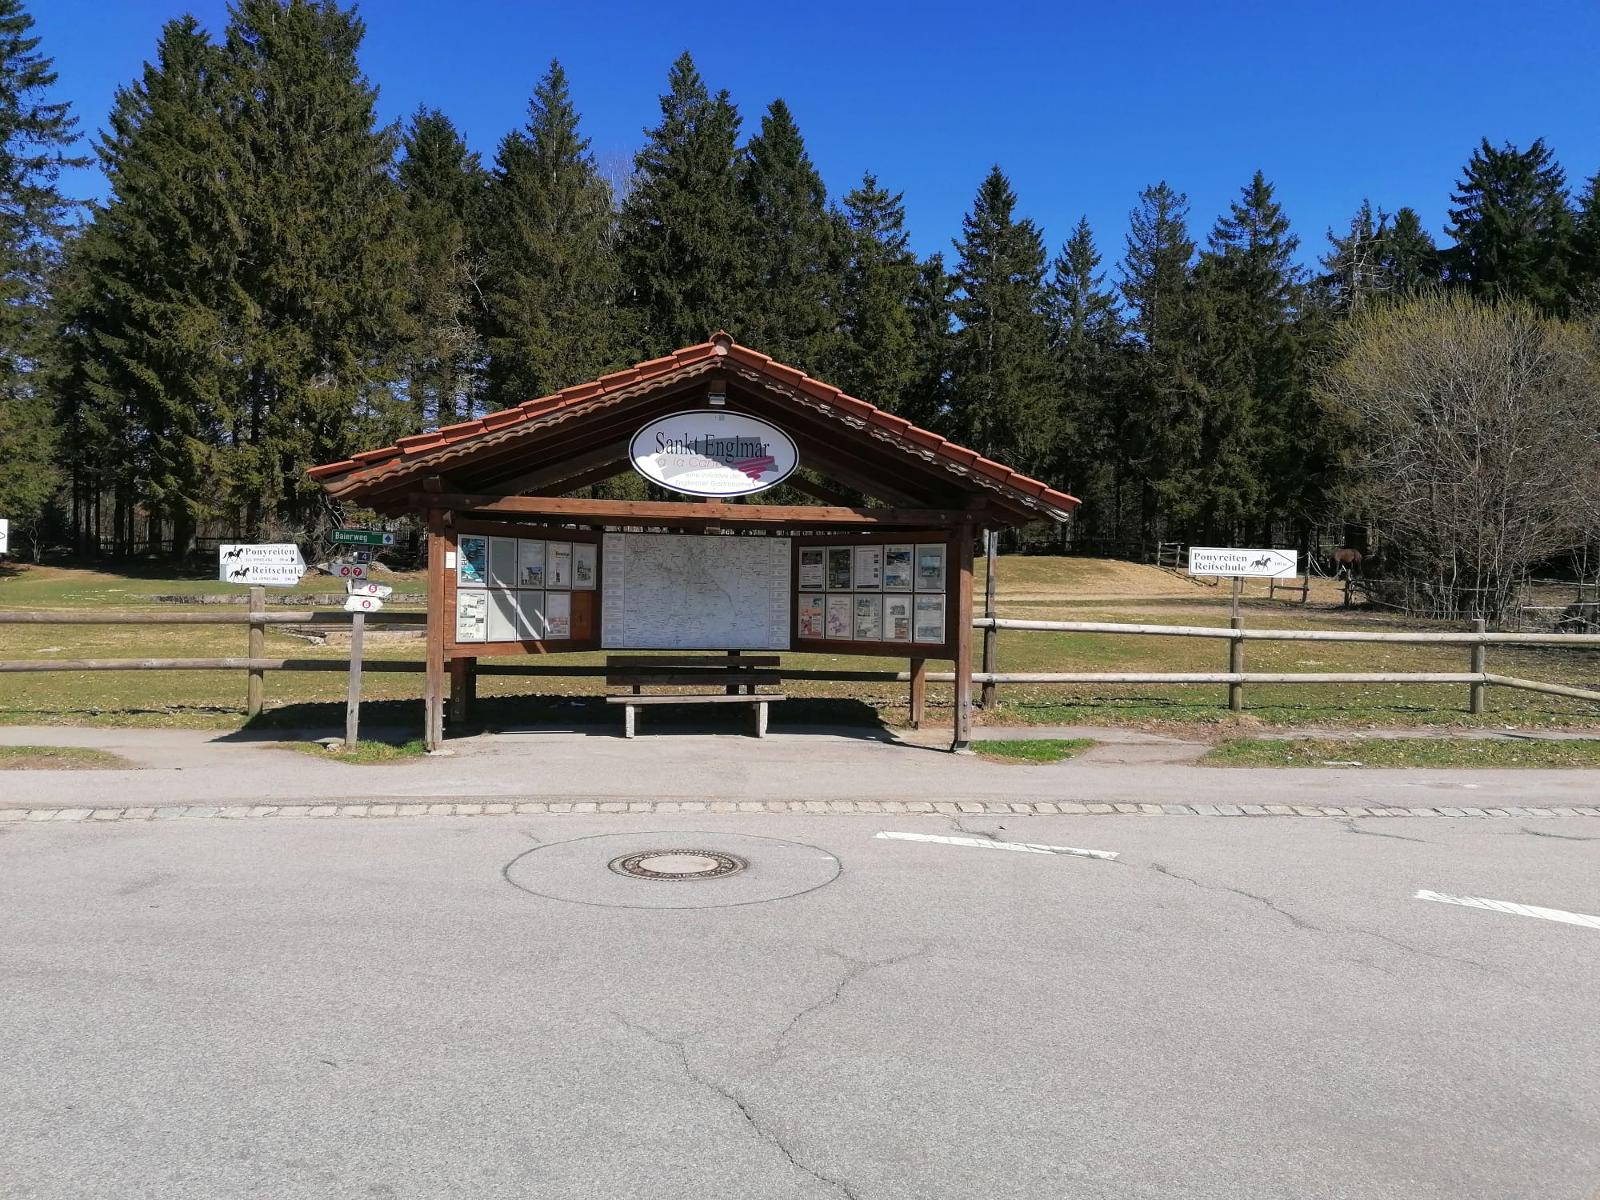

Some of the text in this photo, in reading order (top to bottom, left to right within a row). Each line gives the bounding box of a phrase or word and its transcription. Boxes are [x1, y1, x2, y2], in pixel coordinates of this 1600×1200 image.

[655, 431, 770, 463] Sankt Englmar
[335, 531, 368, 542] Baierweg
[245, 547, 295, 557] Ponyreiten
[1194, 552, 1248, 562] Ponyreiten
[252, 565, 303, 575] Reitschule
[1194, 561, 1247, 572] Reitschule
